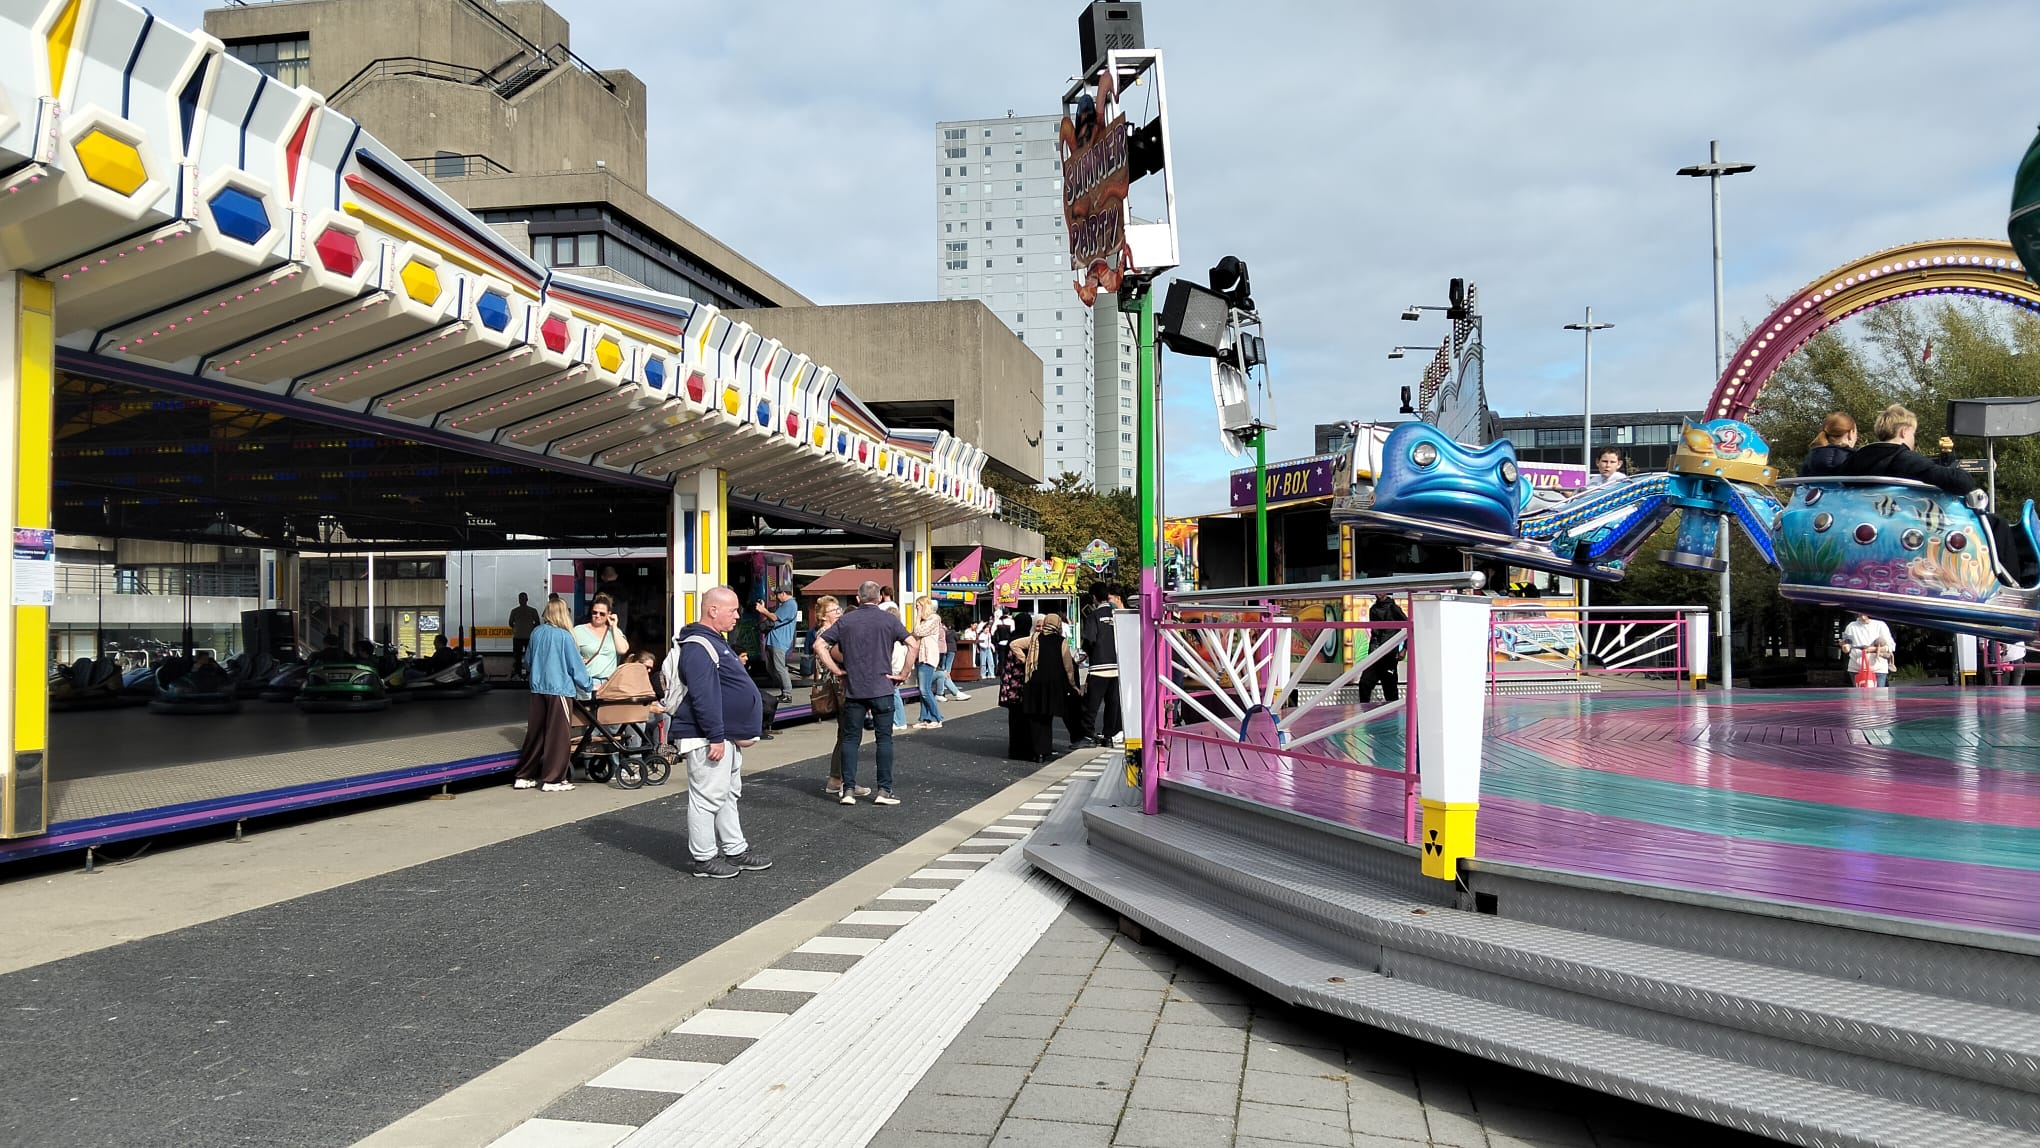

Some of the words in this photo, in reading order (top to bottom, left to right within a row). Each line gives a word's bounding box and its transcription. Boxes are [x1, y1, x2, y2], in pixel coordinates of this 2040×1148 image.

[1066, 123, 1127, 206] SUMMER
[1070, 203, 1119, 258] PARTY
[1721, 430, 1738, 450] 2
[1265, 474, 1280, 498] AY
[1283, 469, 1311, 496] BOX
